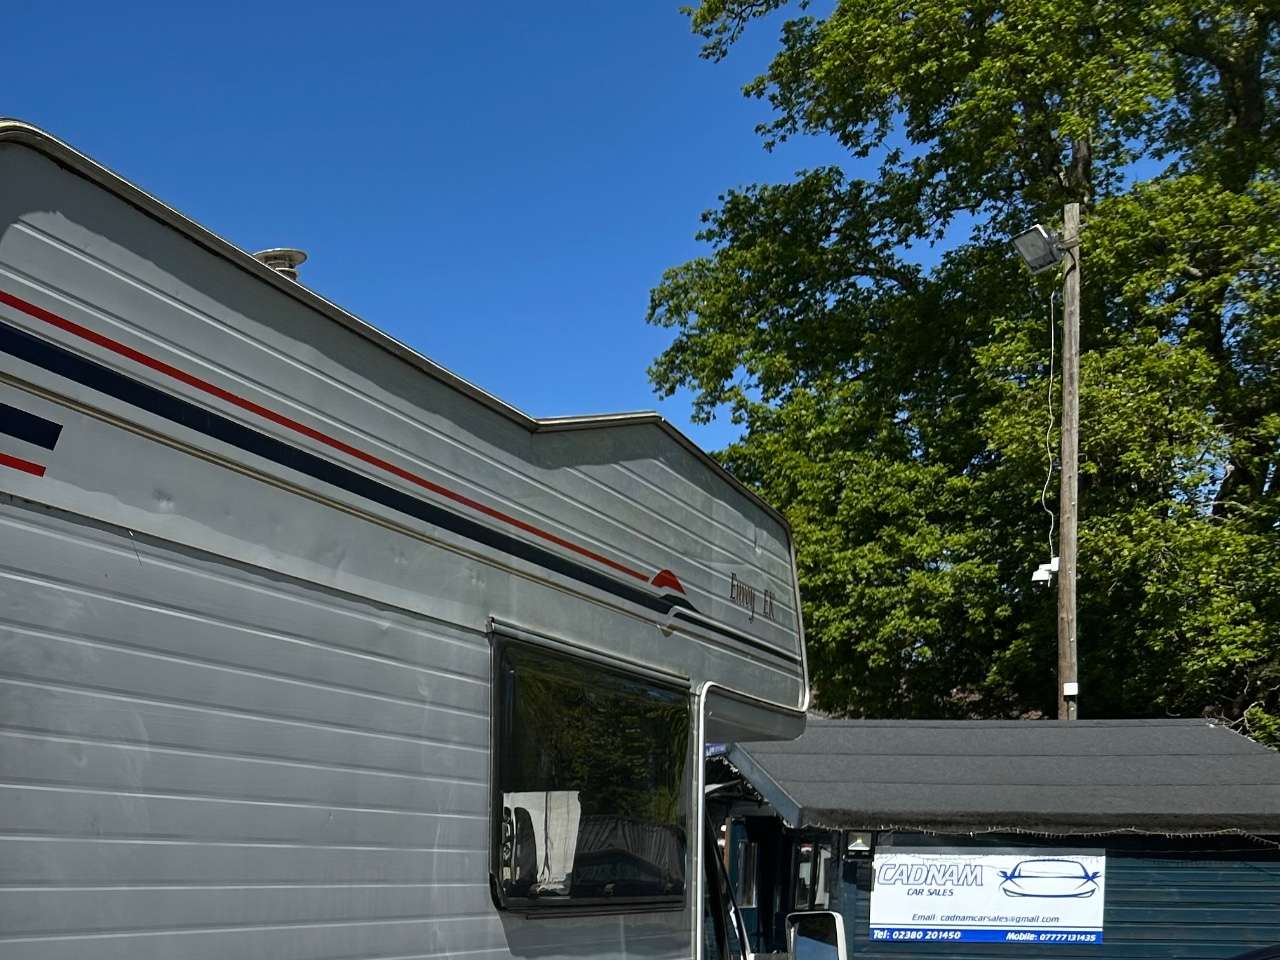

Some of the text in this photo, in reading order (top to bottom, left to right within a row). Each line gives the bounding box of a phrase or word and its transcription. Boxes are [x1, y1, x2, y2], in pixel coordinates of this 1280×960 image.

[878, 863, 983, 886] CADNAM
[907, 888, 954, 897] CAR SALES
[873, 929, 890, 939] Tel:
[892, 931, 923, 939] 02380
[925, 931, 961, 940] 201450
[1006, 932, 1038, 941] Mobile:
